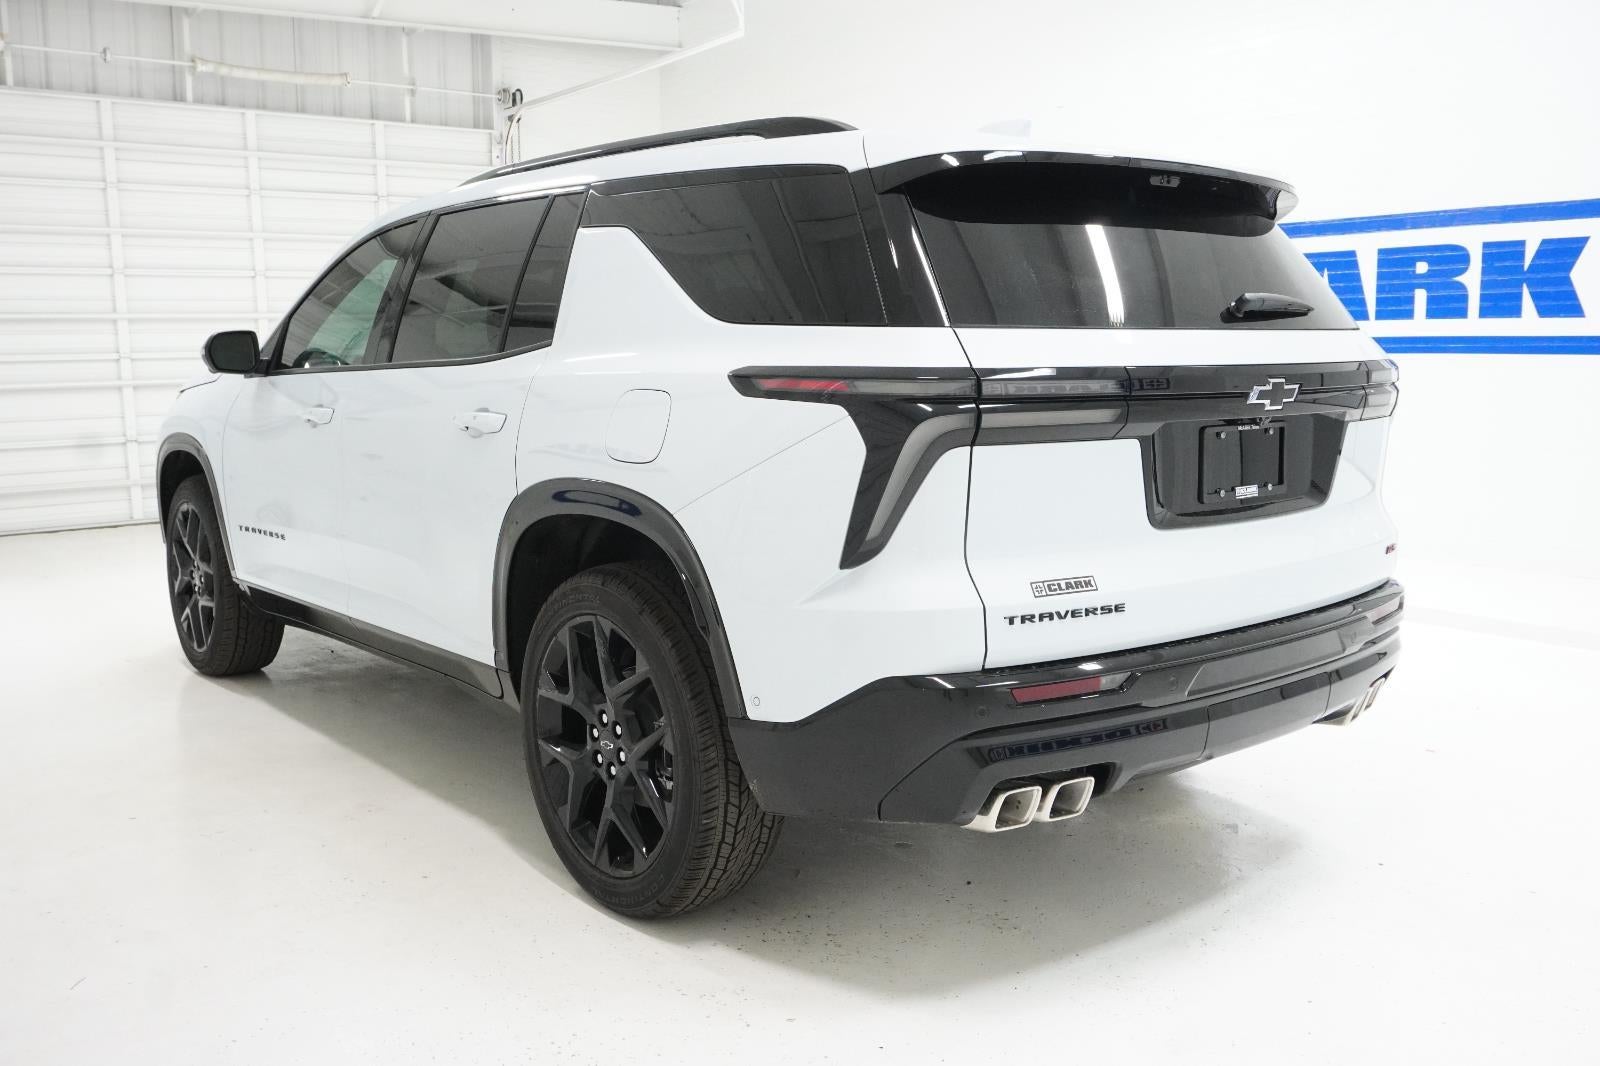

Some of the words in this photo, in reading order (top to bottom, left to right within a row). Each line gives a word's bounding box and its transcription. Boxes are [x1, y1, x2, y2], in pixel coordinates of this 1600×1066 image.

[239, 525, 286, 541] TRAVERSE
[1047, 578, 1094, 593] CLARK
[1004, 603, 1125, 626] TRAVERSE
